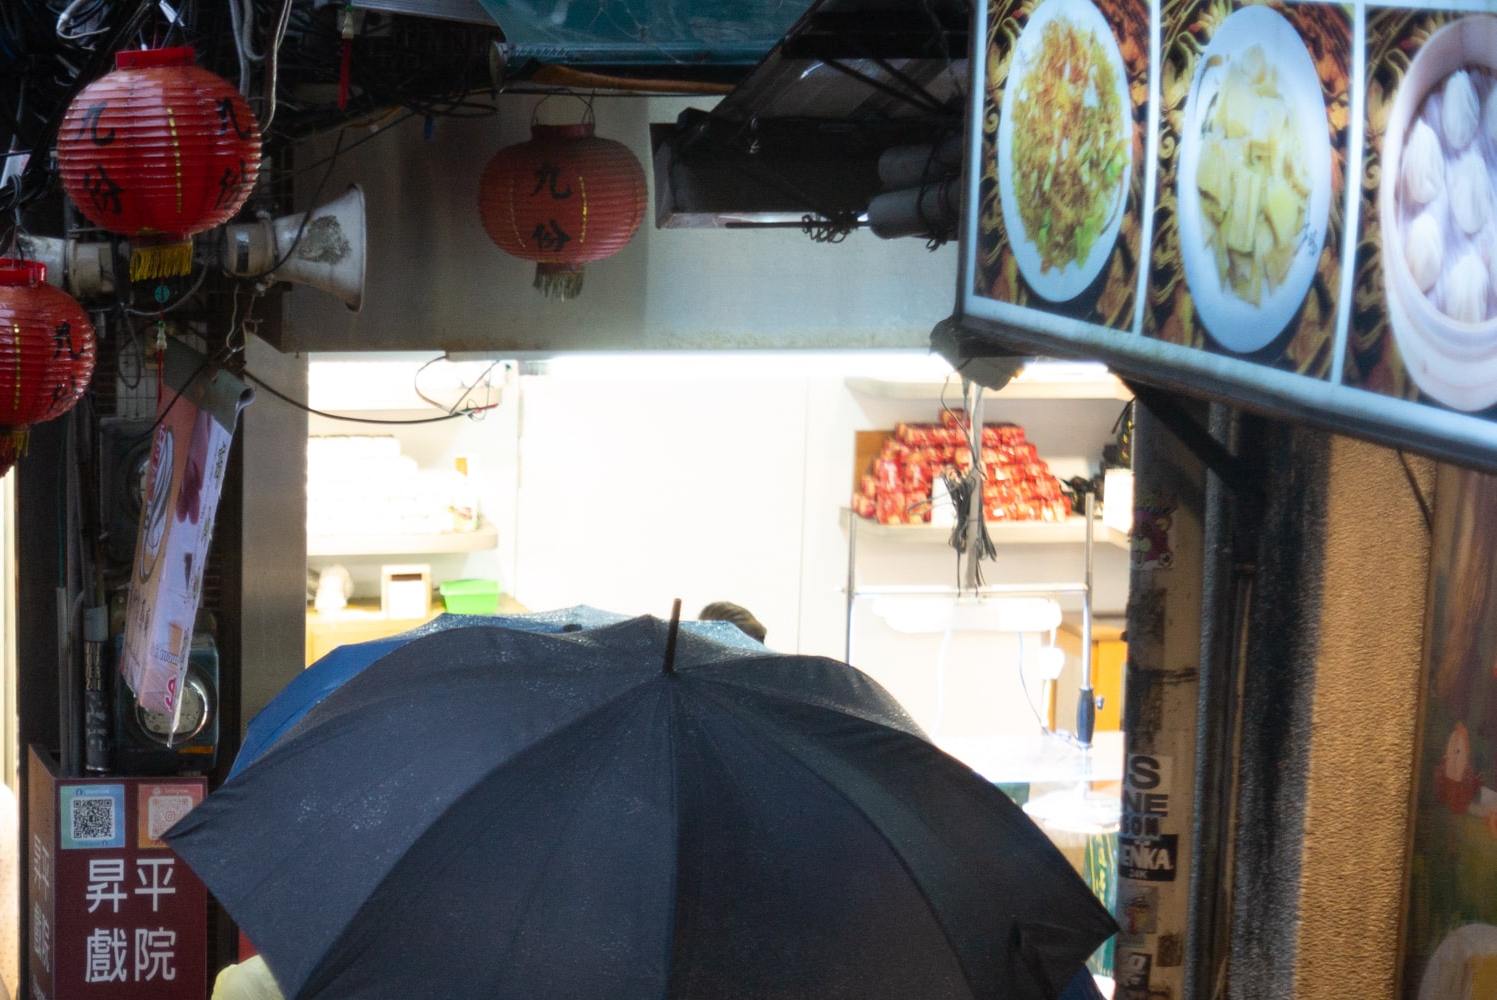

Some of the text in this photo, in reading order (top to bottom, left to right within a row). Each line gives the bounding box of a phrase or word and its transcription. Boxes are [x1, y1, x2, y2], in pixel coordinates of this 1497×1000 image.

[77, 101, 124, 215] 九份
[530, 160, 573, 253] 九份
[84, 857, 177, 914] 昇平
[84, 926, 177, 984] 戲院
